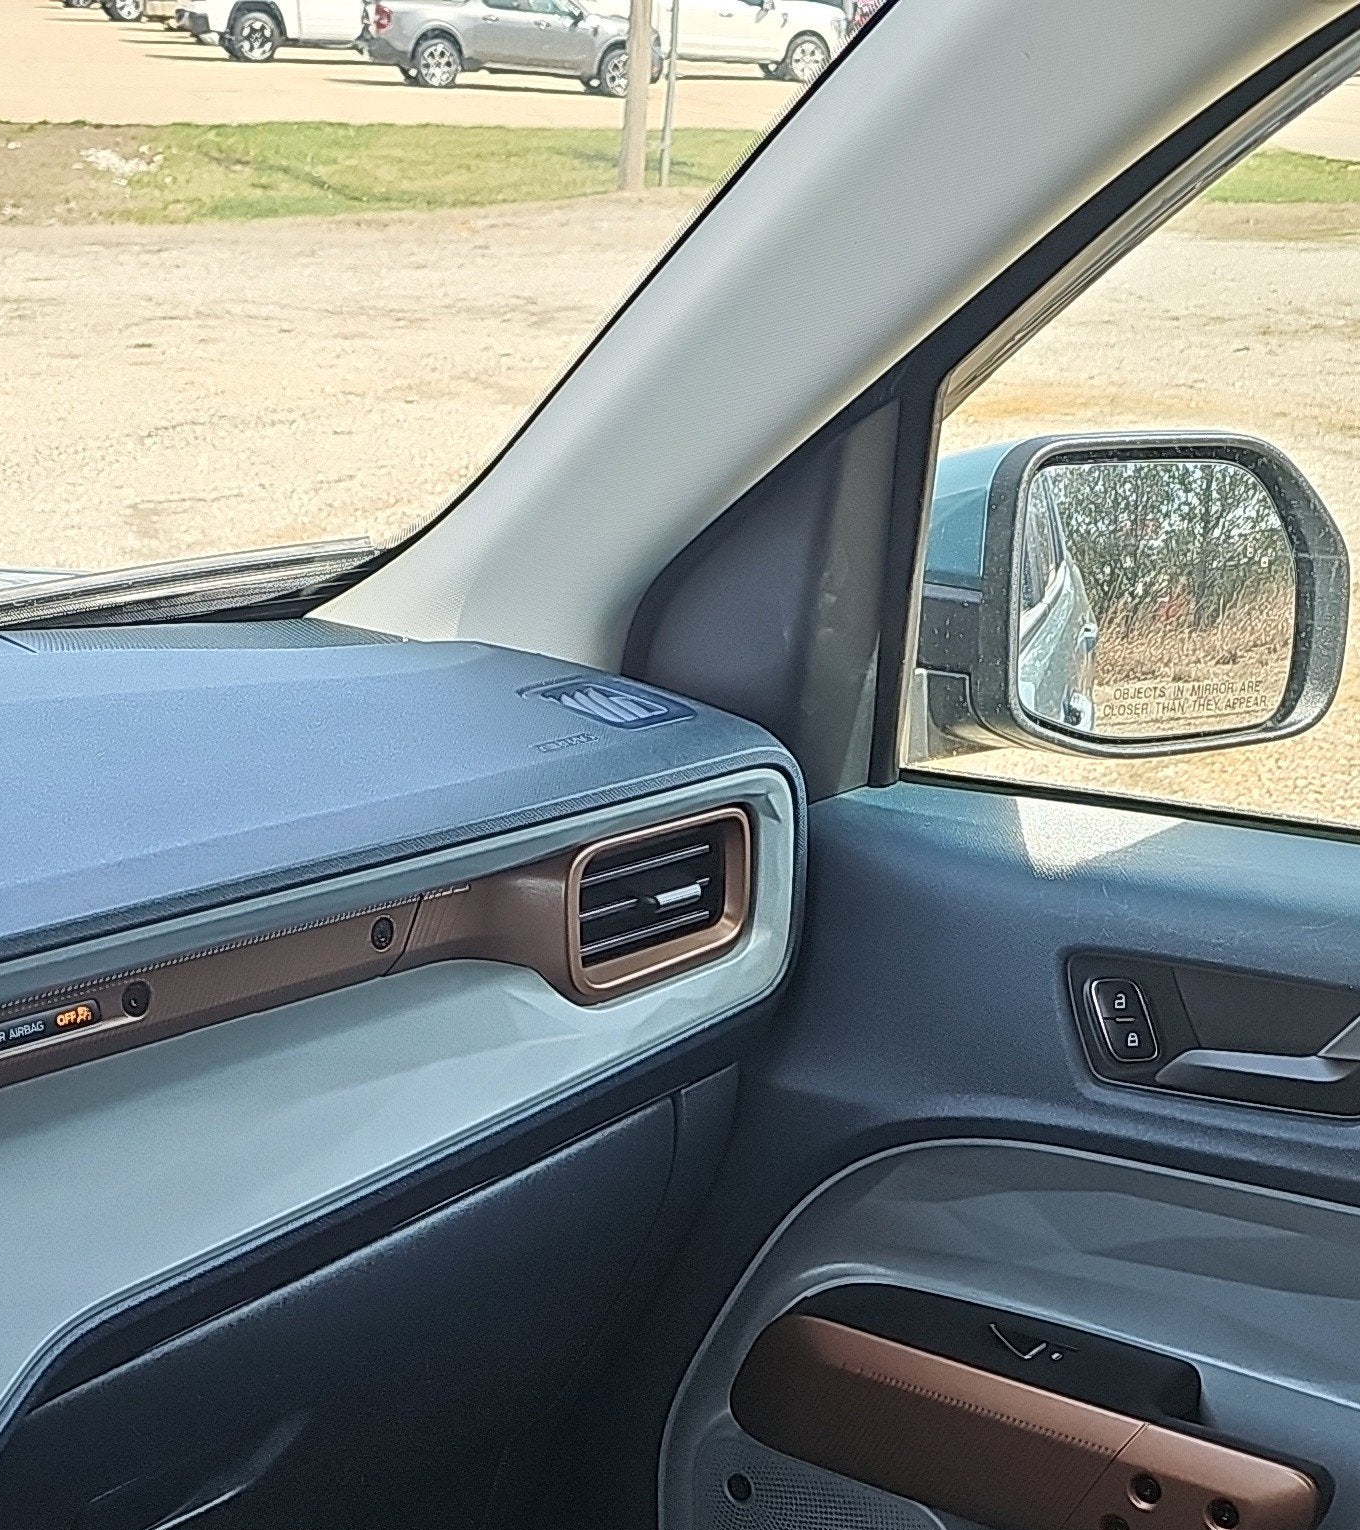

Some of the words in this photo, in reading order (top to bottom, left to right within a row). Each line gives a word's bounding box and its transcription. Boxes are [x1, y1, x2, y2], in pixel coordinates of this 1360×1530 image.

[1113, 686, 1166, 701] OBJECTS
[1173, 685, 1185, 698] IN
[1190, 681, 1234, 697] MIRROR
[1239, 680, 1262, 693] ARE
[1103, 703, 1148, 717] CLOSER
[1156, 701, 1186, 714] THAN
[1192, 698, 1219, 711] THEY
[1225, 695, 1267, 710] APPEAR
[8, 1021, 45, 1041] AIRBAG
[56, 1012, 77, 1027] OFF
